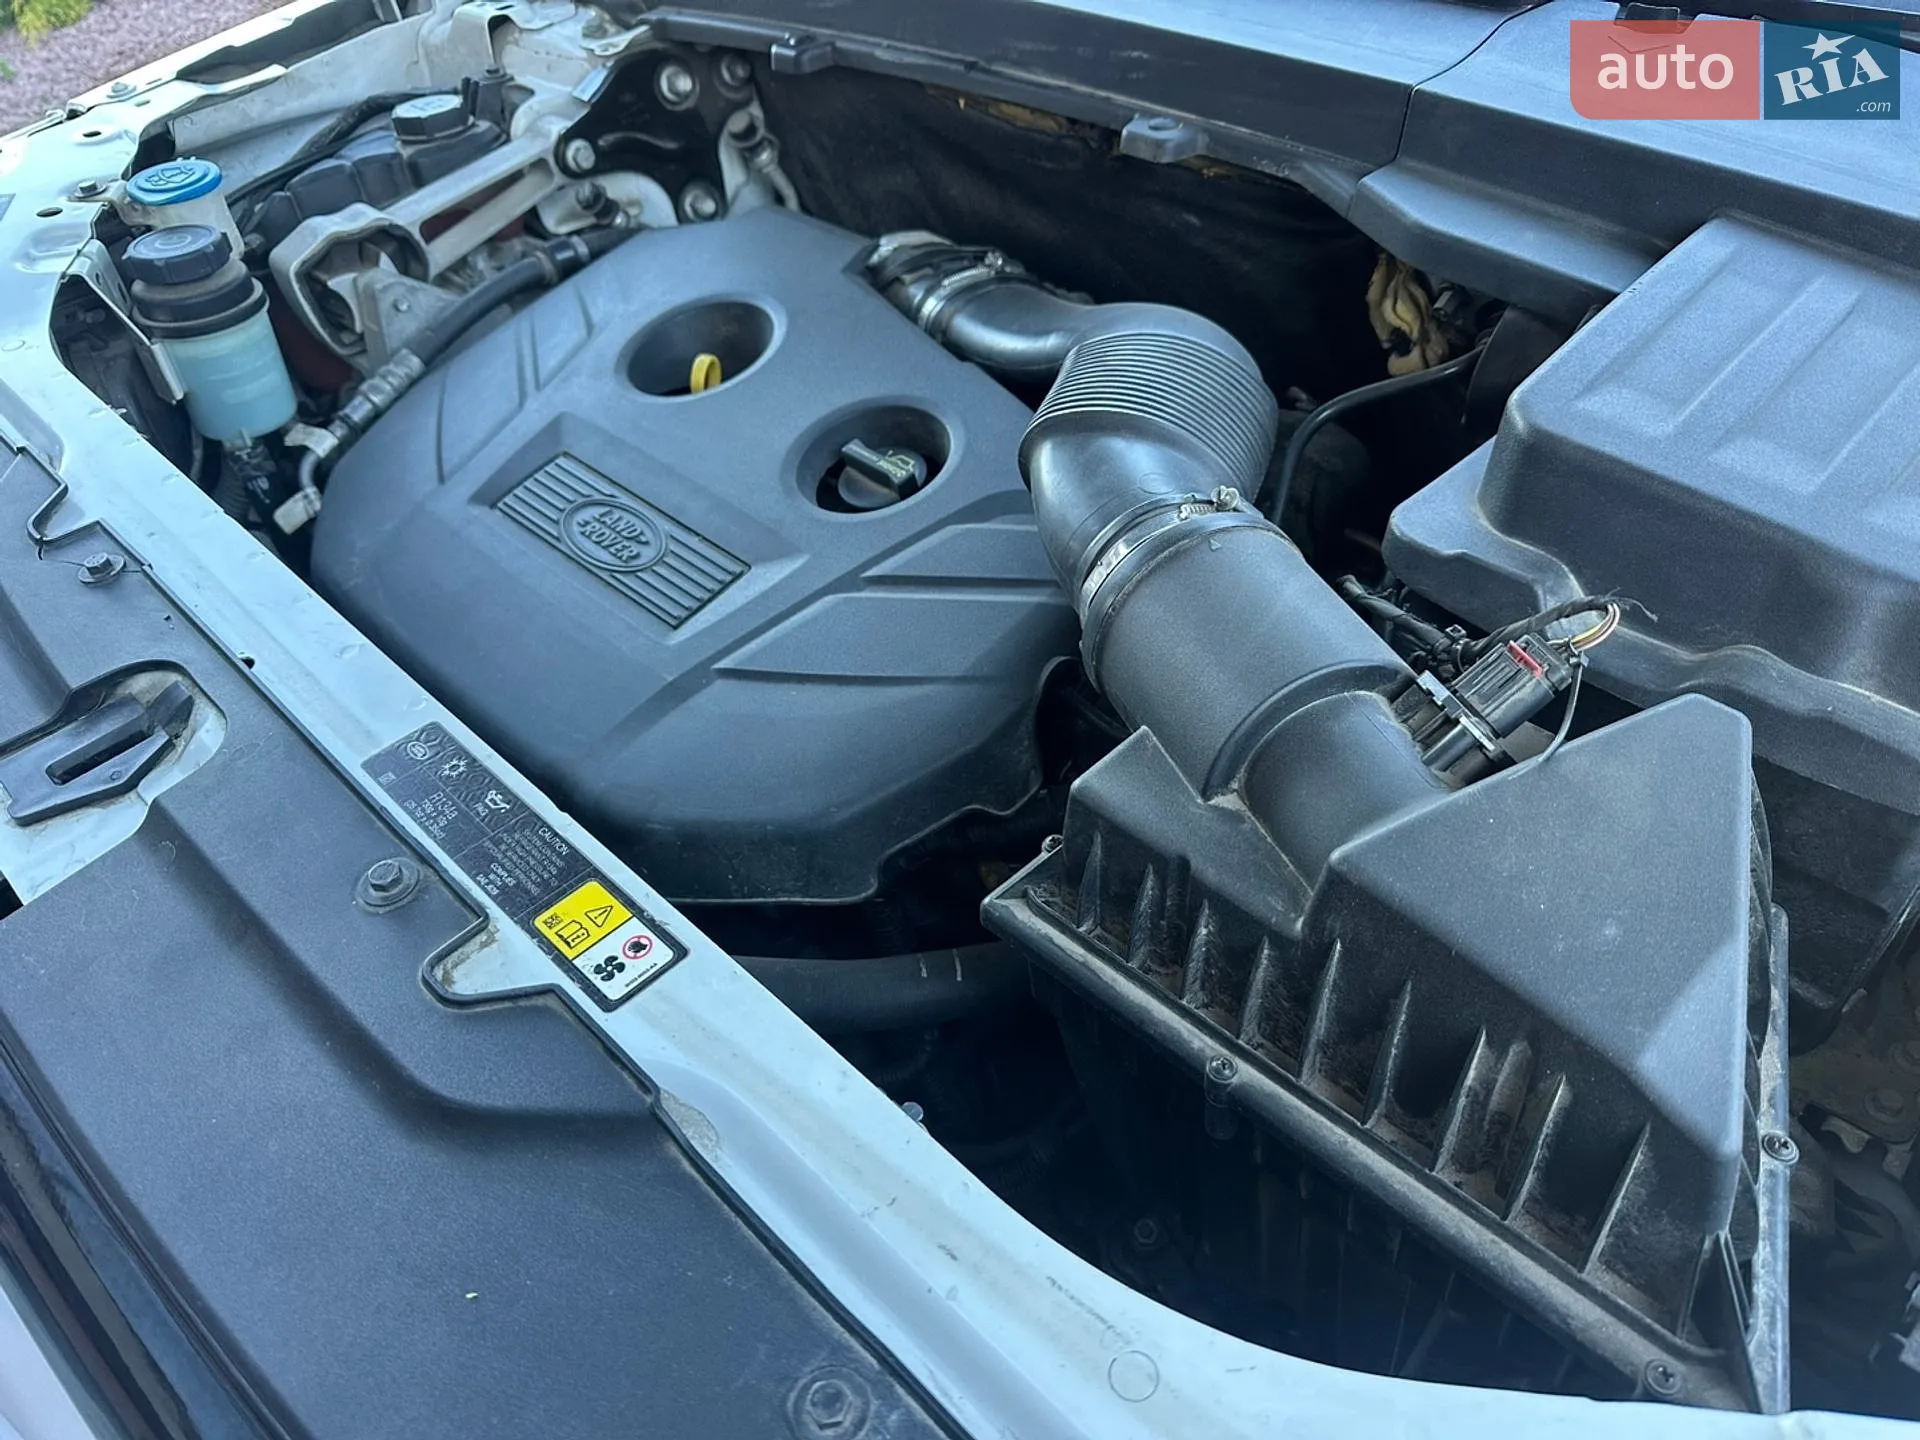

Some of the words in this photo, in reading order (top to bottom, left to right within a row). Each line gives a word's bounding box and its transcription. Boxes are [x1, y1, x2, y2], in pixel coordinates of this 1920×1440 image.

[593, 509, 641, 539] LAND
[582, 521, 641, 562] ROVER
[428, 792, 458, 820] R134a
[538, 828, 569, 854] CAUTION
